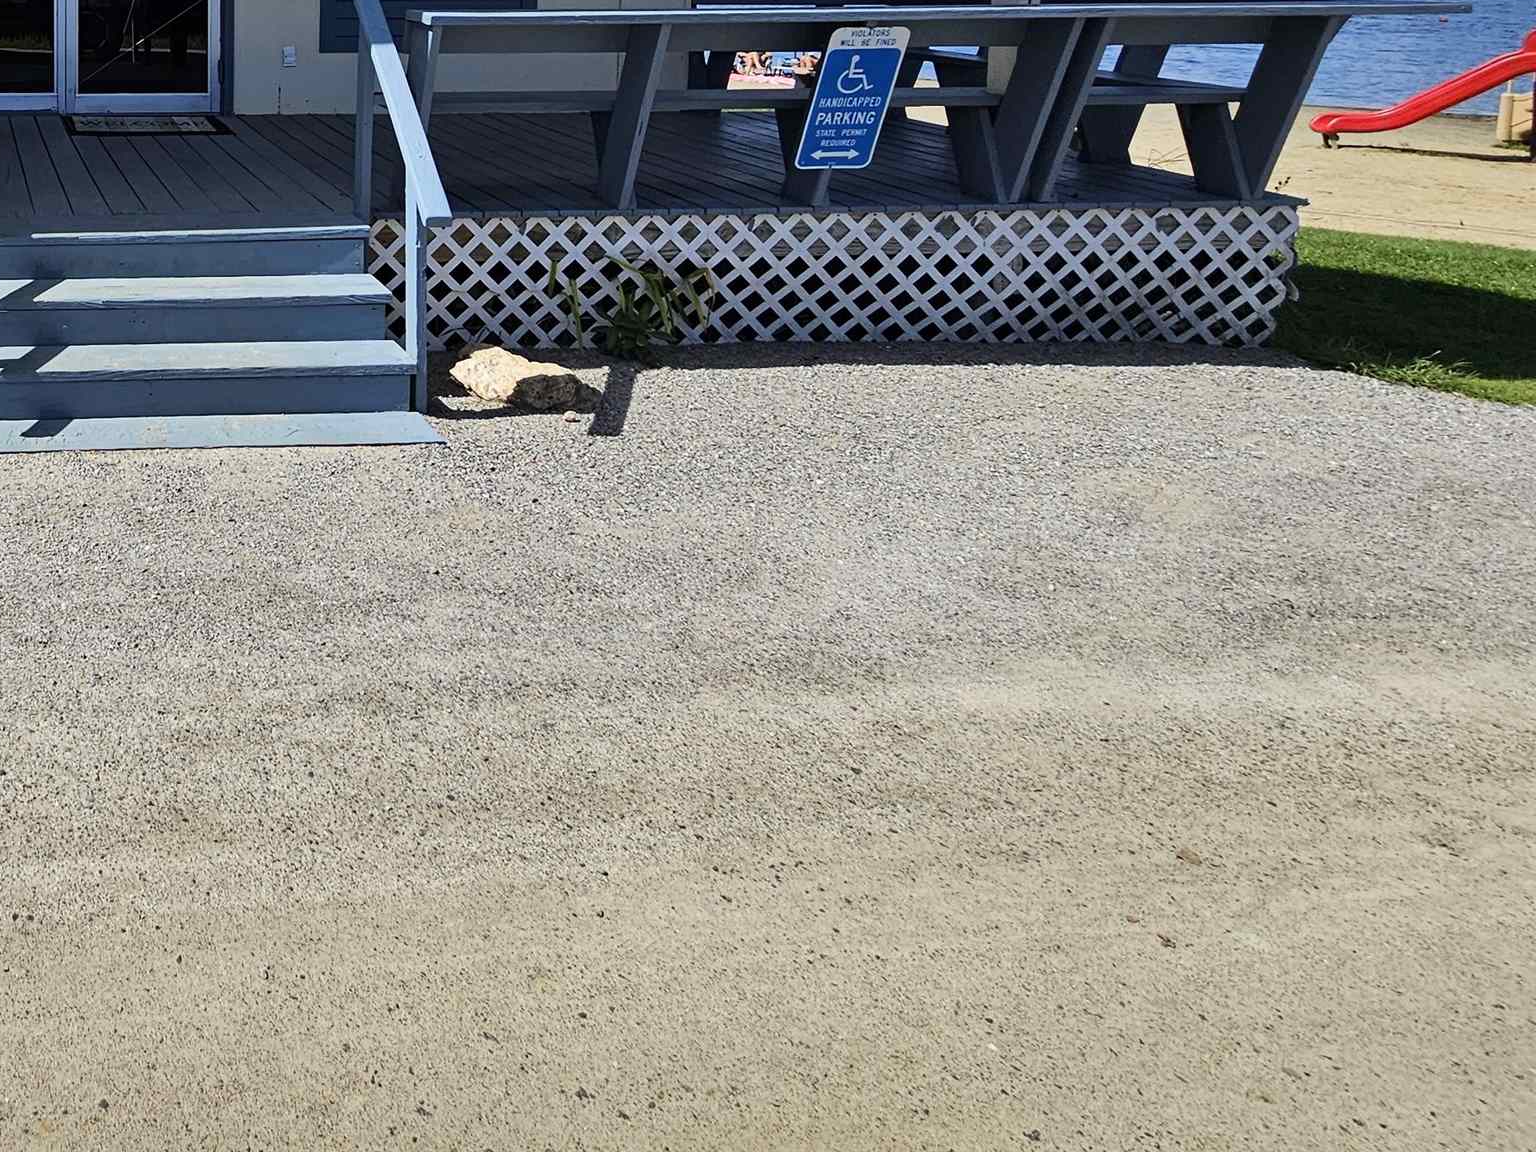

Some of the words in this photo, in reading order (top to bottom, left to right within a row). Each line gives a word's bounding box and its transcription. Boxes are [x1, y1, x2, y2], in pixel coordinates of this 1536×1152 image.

[850, 28, 890, 38] VIOLATORS
[840, 39, 857, 47] WILL
[861, 38, 871, 46] BE
[875, 38, 896, 46] FINED
[819, 96, 882, 108] HANDICAPPED
[815, 111, 876, 127] PARKING
[815, 128, 837, 137] STATE
[841, 128, 867, 137] PERMIT
[820, 138, 857, 147] REQUIRED
